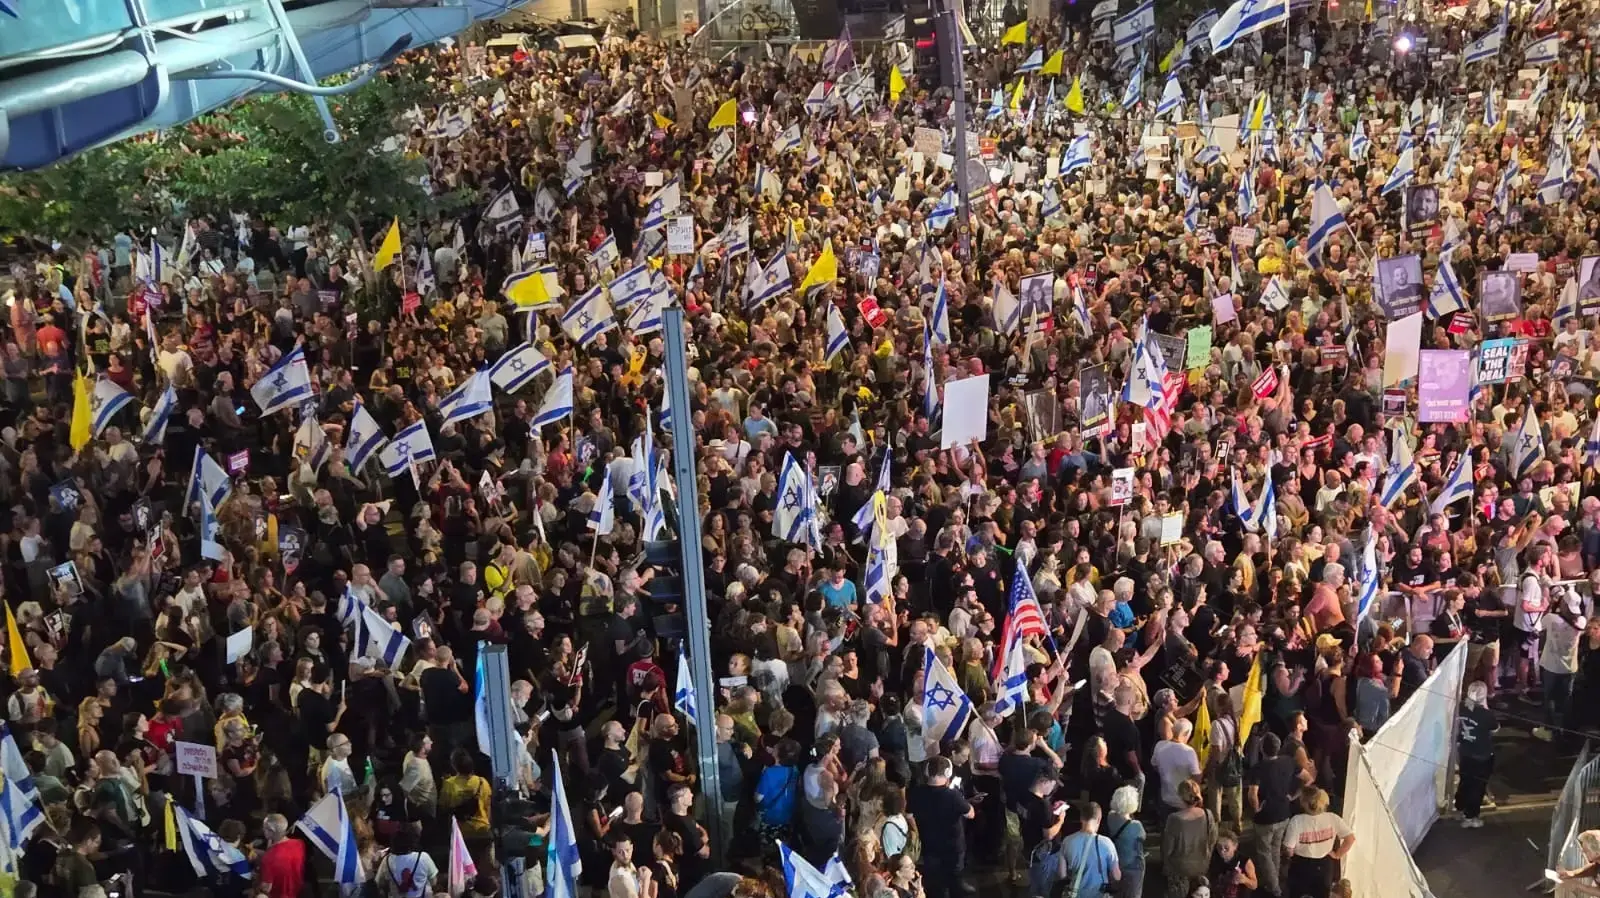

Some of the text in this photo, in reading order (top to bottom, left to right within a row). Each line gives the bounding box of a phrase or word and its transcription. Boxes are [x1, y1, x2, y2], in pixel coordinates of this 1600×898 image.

[1483, 346, 1508, 359] SEAL
[1485, 358, 1505, 370] THE
[1479, 368, 1504, 381] DEAL
